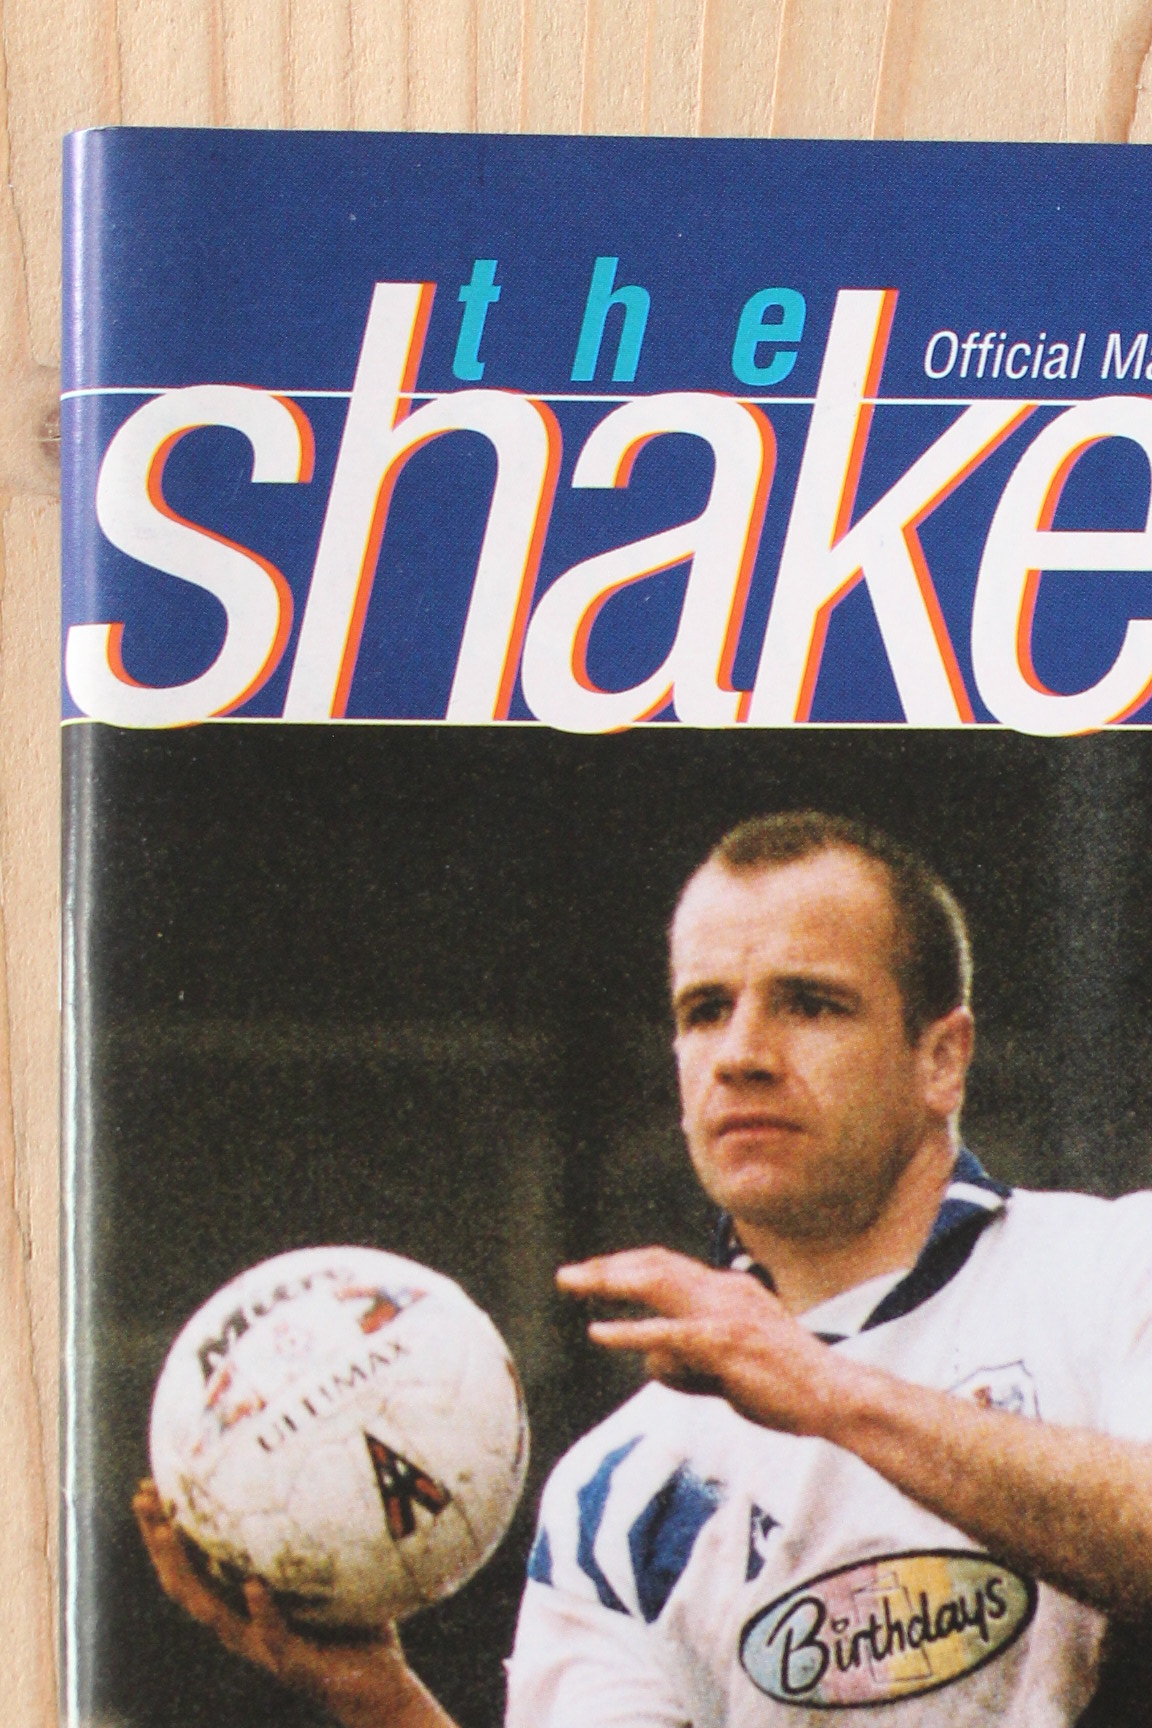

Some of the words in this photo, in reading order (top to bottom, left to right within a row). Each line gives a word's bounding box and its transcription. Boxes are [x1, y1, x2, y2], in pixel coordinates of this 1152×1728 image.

[451, 257, 807, 386] the
[924, 330, 1086, 381] Official
[767, 1576, 1008, 1695] Birthdays
